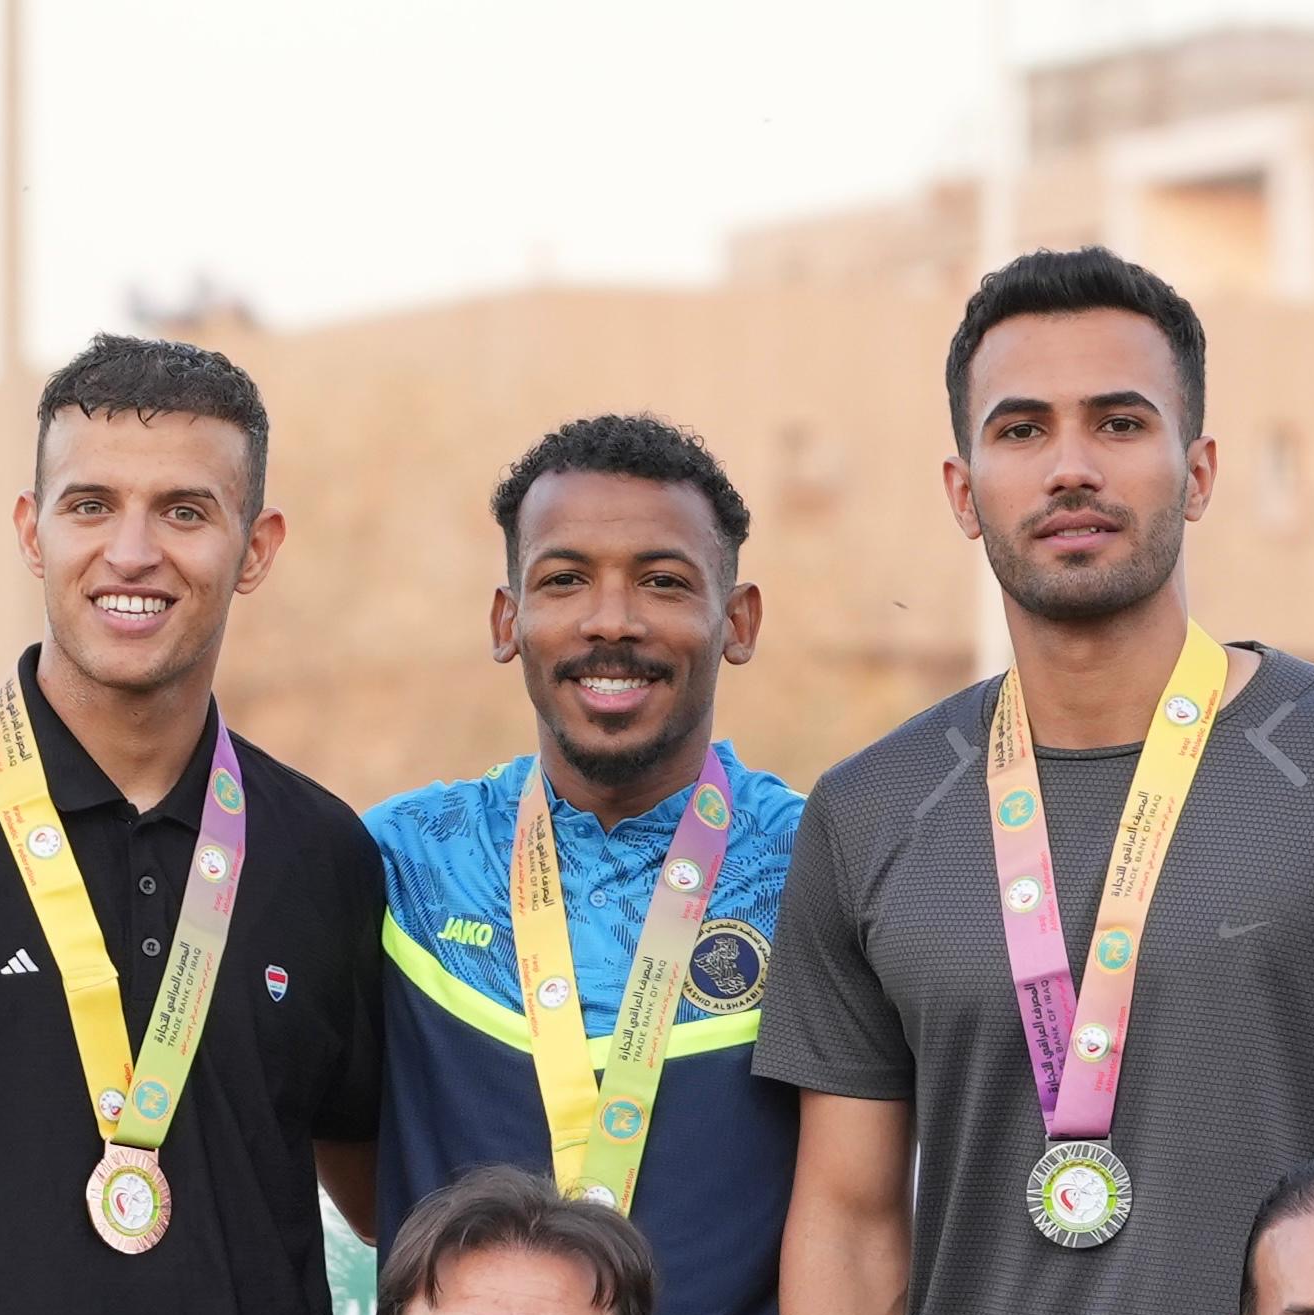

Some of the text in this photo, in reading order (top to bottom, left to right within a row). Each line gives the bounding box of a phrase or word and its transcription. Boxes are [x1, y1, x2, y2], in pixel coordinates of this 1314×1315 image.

[1132, 790, 1150, 826] المصرف
[1122, 825, 1138, 865] العراقي
[437, 917, 493, 947] JAKO
[178, 940, 191, 977] المصرف
[639, 956, 654, 991] المصرف
[166, 974, 182, 1014] العراقي
[628, 990, 645, 1029] العراقي
[712, 989, 761, 1011] ALSHAABI
[1023, 982, 1043, 1020] المصرف
[1040, 979, 1053, 1005] IRAQ
[1032, 1020, 1055, 1060] العراقي
[1051, 1023, 1065, 1054] BANK
